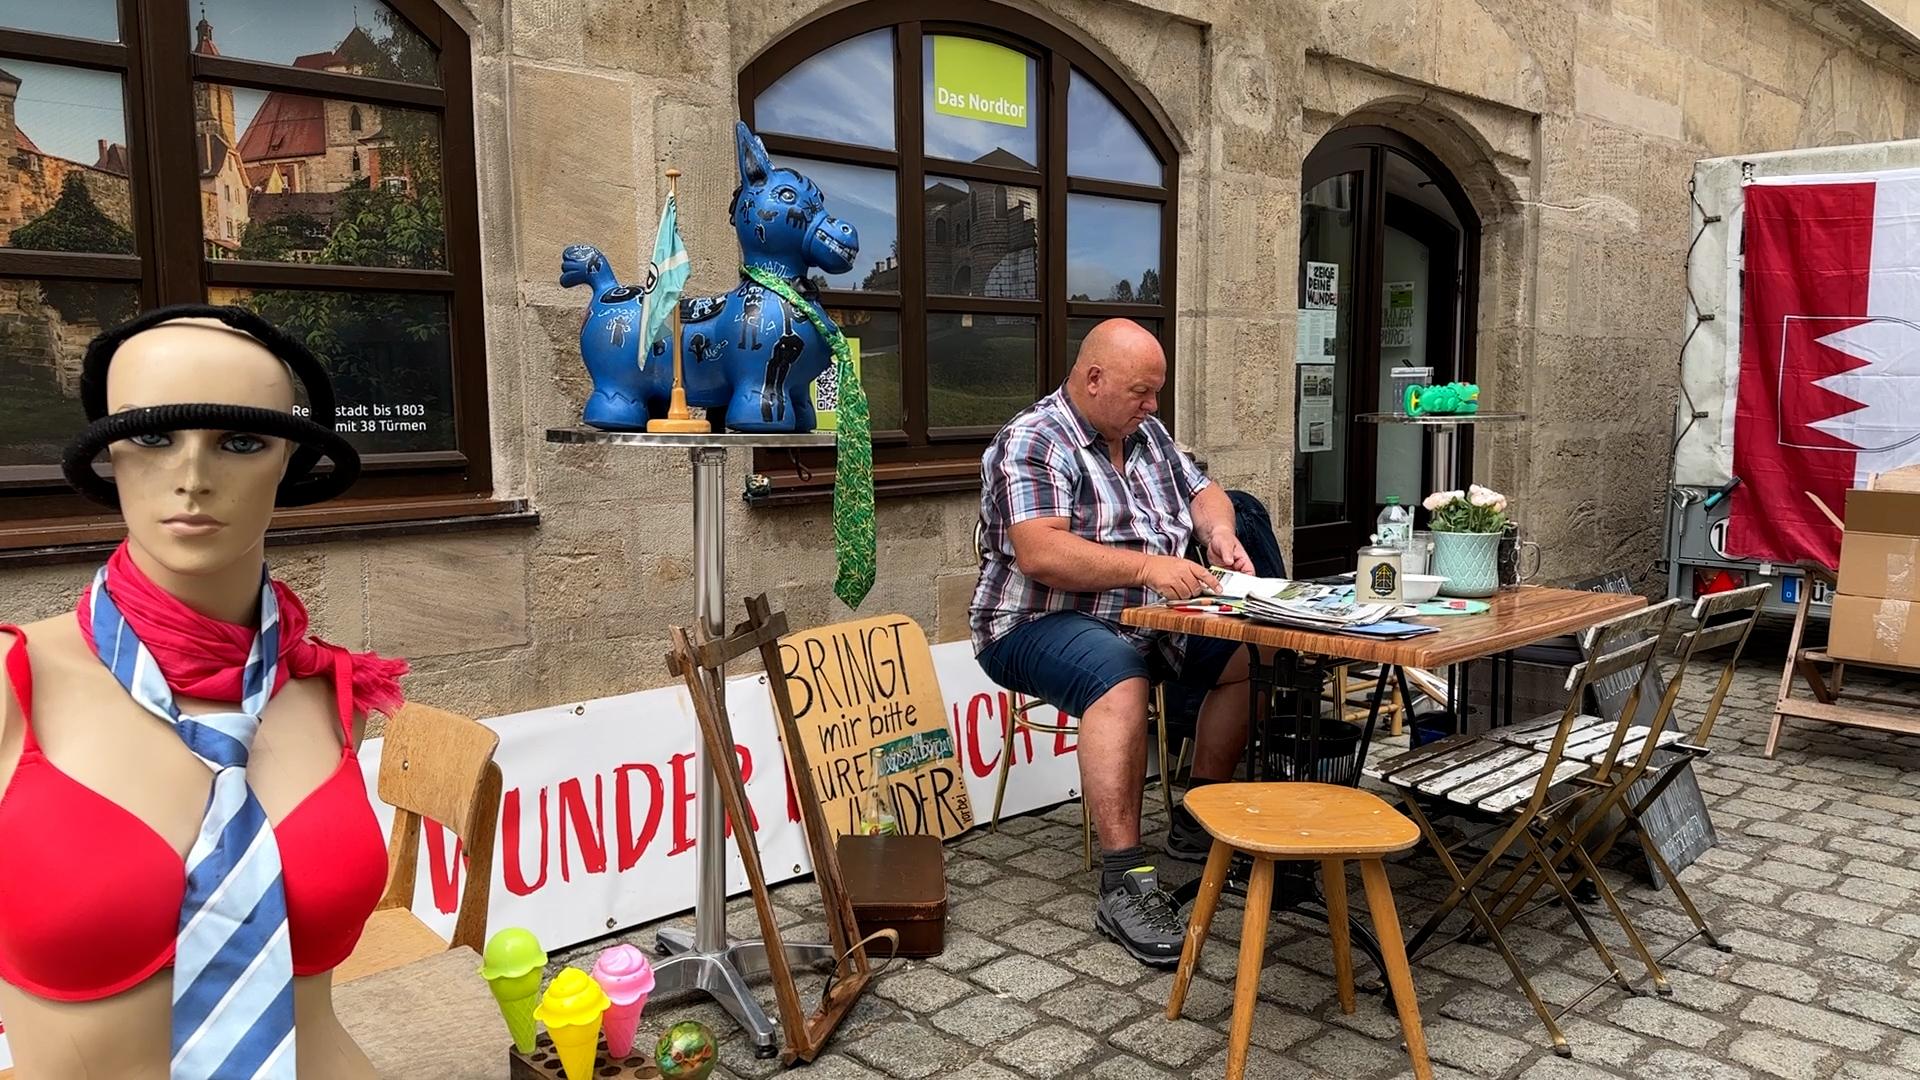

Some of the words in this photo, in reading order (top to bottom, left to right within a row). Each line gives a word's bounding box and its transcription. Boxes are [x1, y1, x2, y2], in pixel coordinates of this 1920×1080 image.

[938, 87, 965, 108] Das
[969, 92, 1025, 118] Nordtor
[1308, 277, 1331, 291] DEINE
[292, 404, 369, 417] Restadt
[373, 404, 391, 416] bis
[395, 404, 425, 416] 1803
[335, 420, 357, 432] mit
[360, 420, 376, 432] 38
[379, 419, 427, 431] Türmen
[1786, 591, 1792, 599] D
[778, 622, 910, 720] BRINGT
[818, 713, 862, 754] mir
[867, 700, 918, 738] bitte
[810, 752, 869, 804] URE
